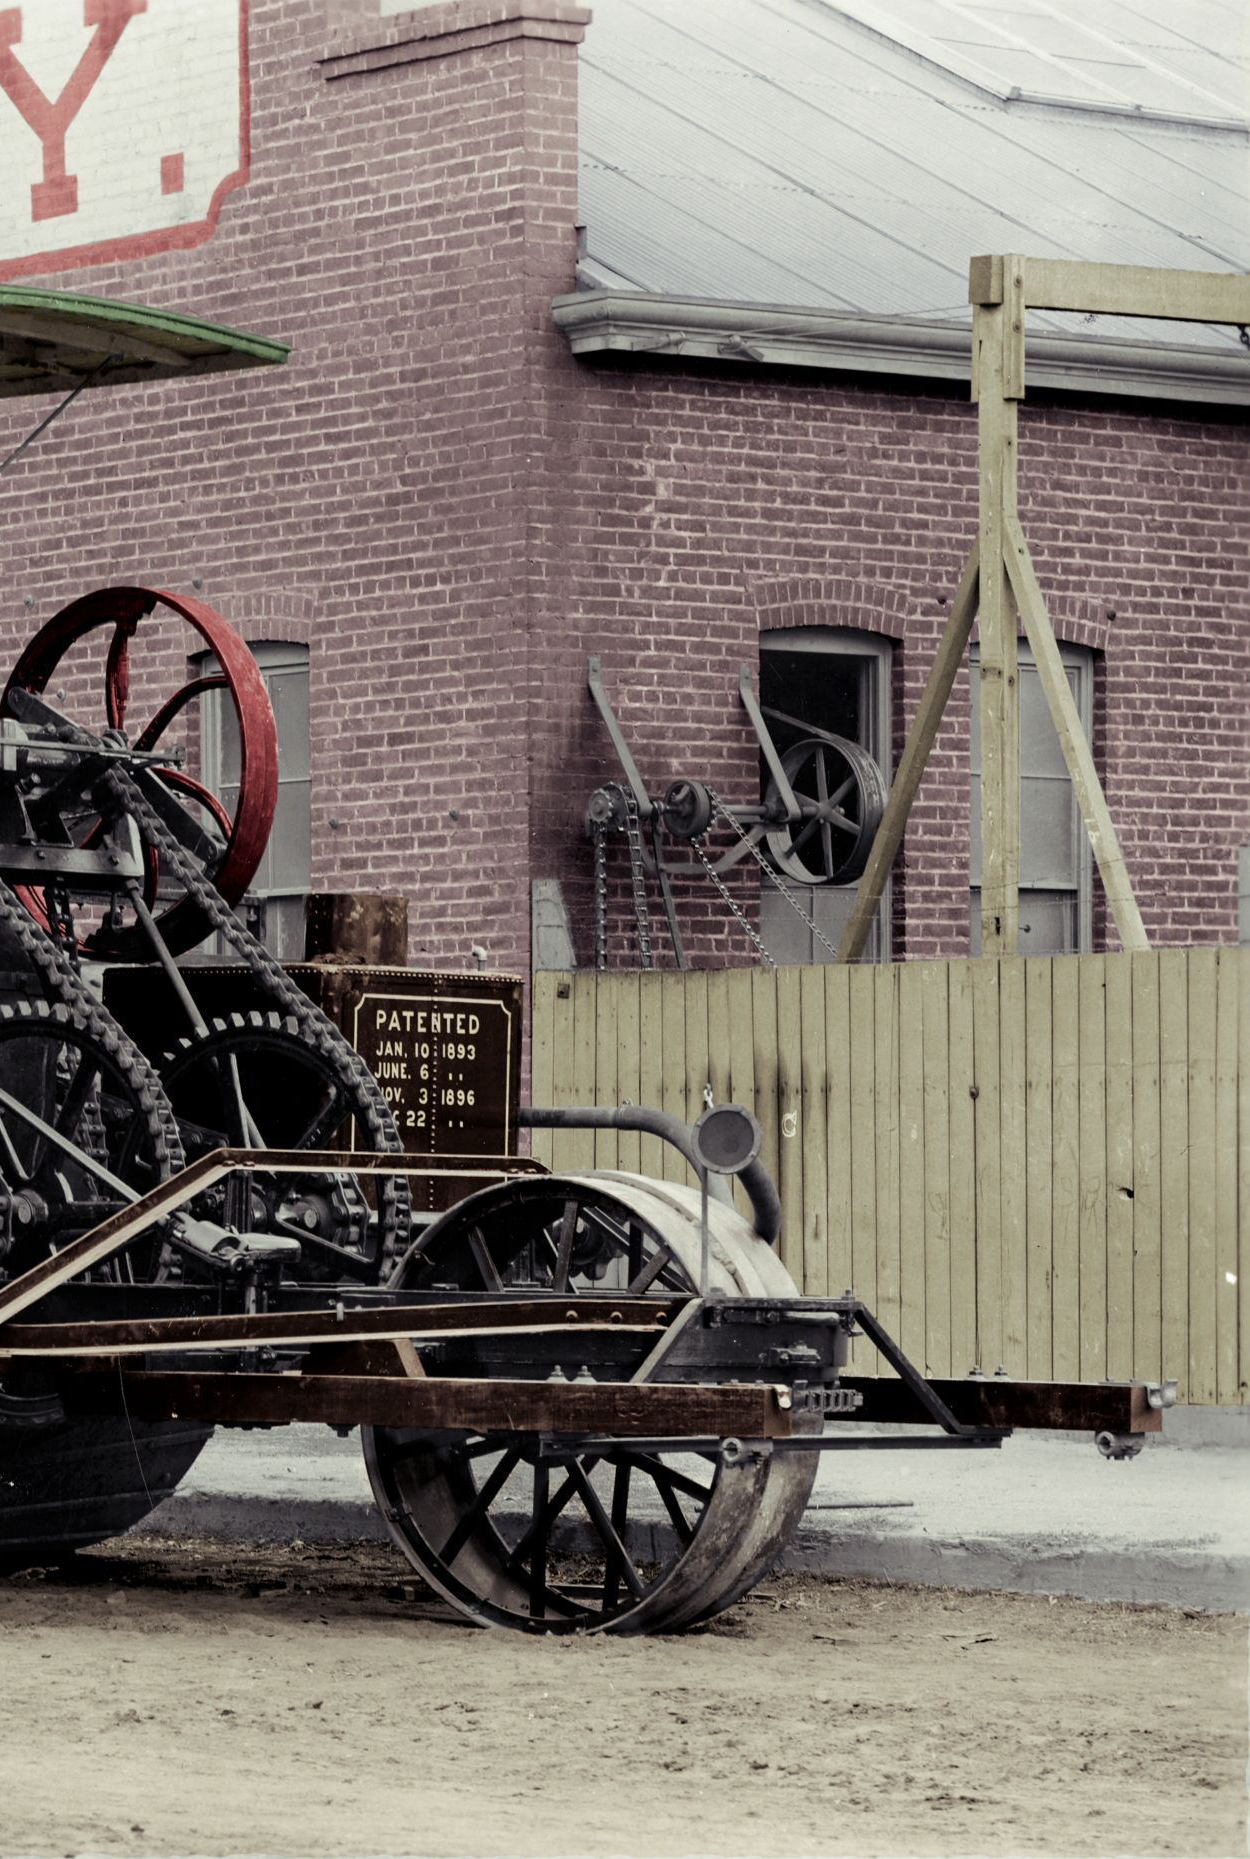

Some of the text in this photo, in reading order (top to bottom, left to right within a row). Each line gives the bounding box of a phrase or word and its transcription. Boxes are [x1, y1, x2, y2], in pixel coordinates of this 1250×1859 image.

[376, 1009, 480, 1035] PATENTED
[414, 1042, 430, 1059] 10
[442, 1043, 476, 1060] 1893
[419, 1063, 429, 1080] 6
[418, 1088, 428, 1104] 3
[441, 1089, 475, 1106] 1896
[406, 1110, 426, 1127] 22
